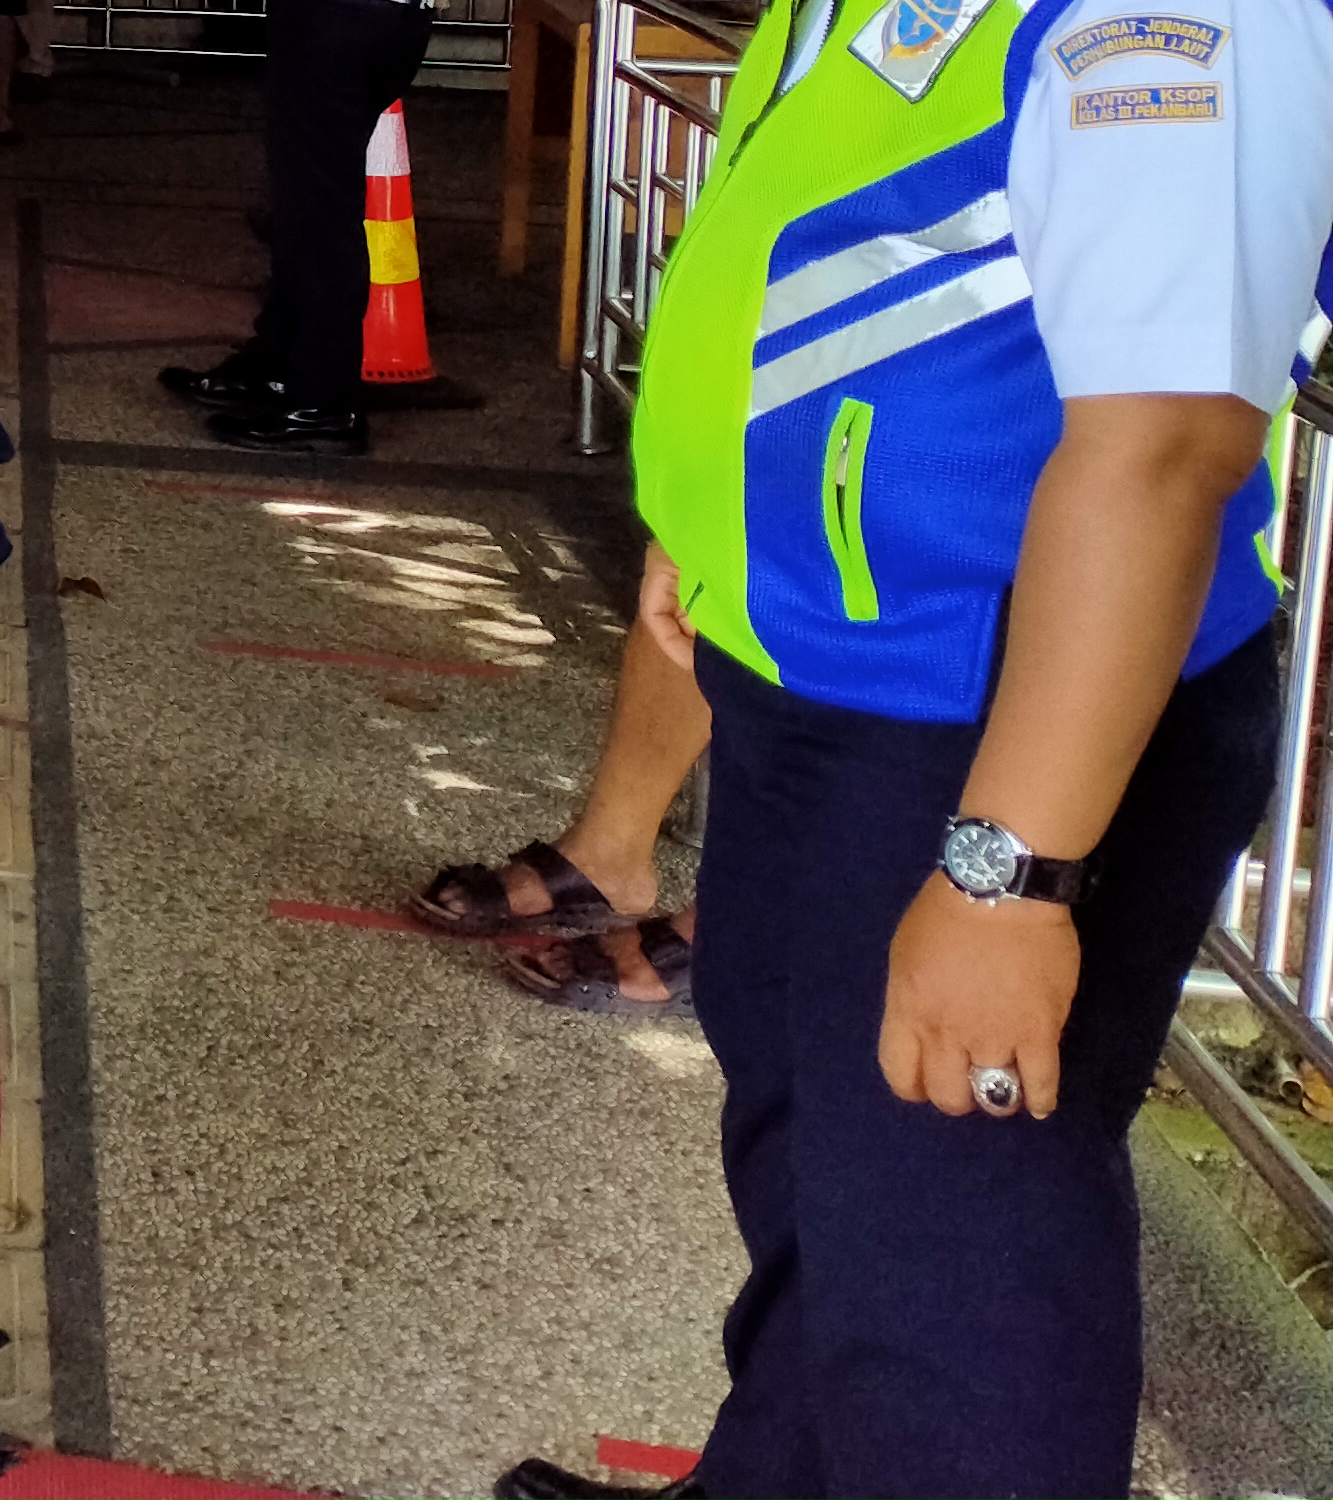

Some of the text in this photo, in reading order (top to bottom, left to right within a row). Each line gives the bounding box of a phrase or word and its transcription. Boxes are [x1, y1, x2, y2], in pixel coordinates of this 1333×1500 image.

[1062, 20, 1138, 58] DIREKTORAT
[1171, 36, 1212, 60] LAUT
[1078, 88, 1214, 110] KANTOR KSOP
